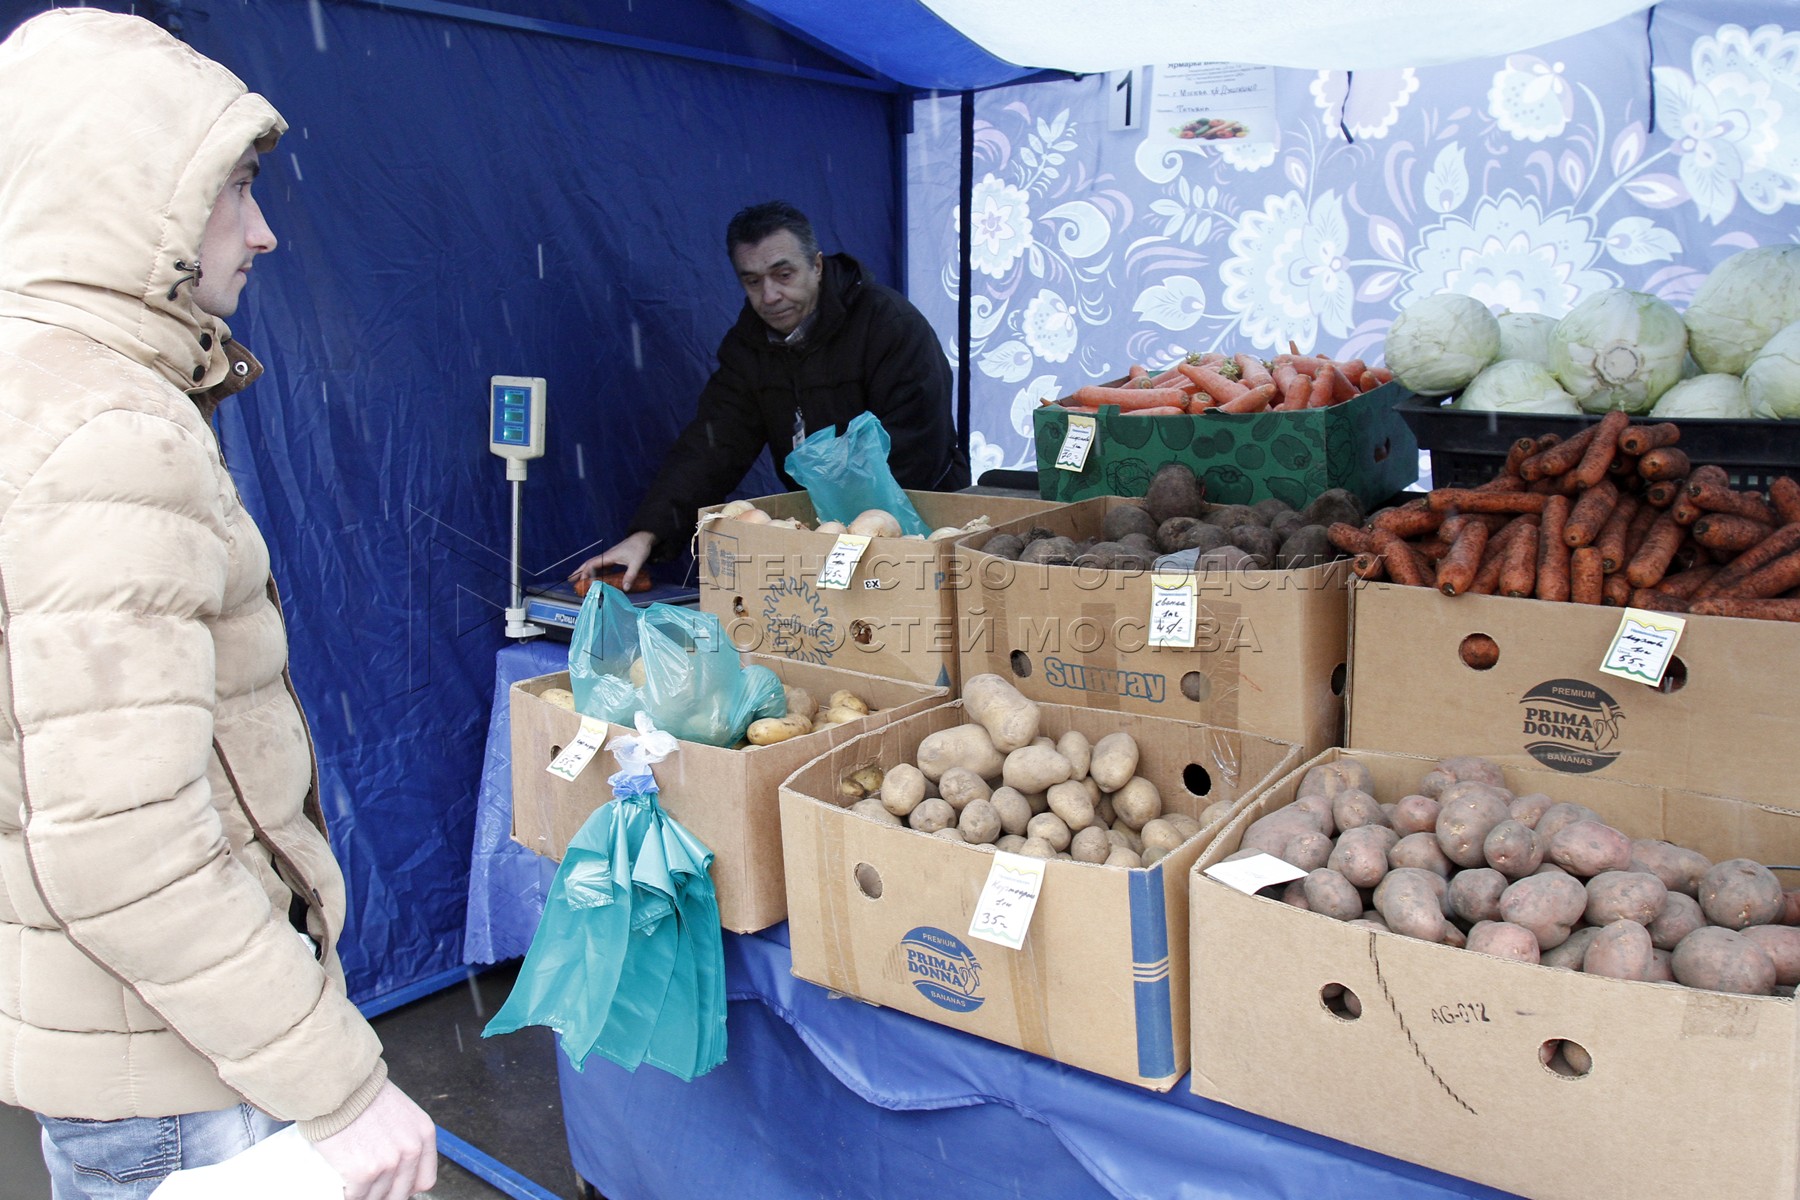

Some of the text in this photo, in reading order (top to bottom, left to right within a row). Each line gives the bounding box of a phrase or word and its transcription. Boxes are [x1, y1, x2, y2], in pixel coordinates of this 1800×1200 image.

[1116, 70, 1133, 126] 1
[1551, 686, 1596, 700] PREMIUM
[1524, 707, 1593, 729] PRIMA
[1522, 720, 1596, 743] DONNA
[1547, 752, 1593, 767] BANANAS
[922, 932, 957, 949] PREMIUM
[906, 948, 960, 975] PRIMA
[907, 959, 965, 988] DONNA
[930, 990, 966, 1007] BANANAS
